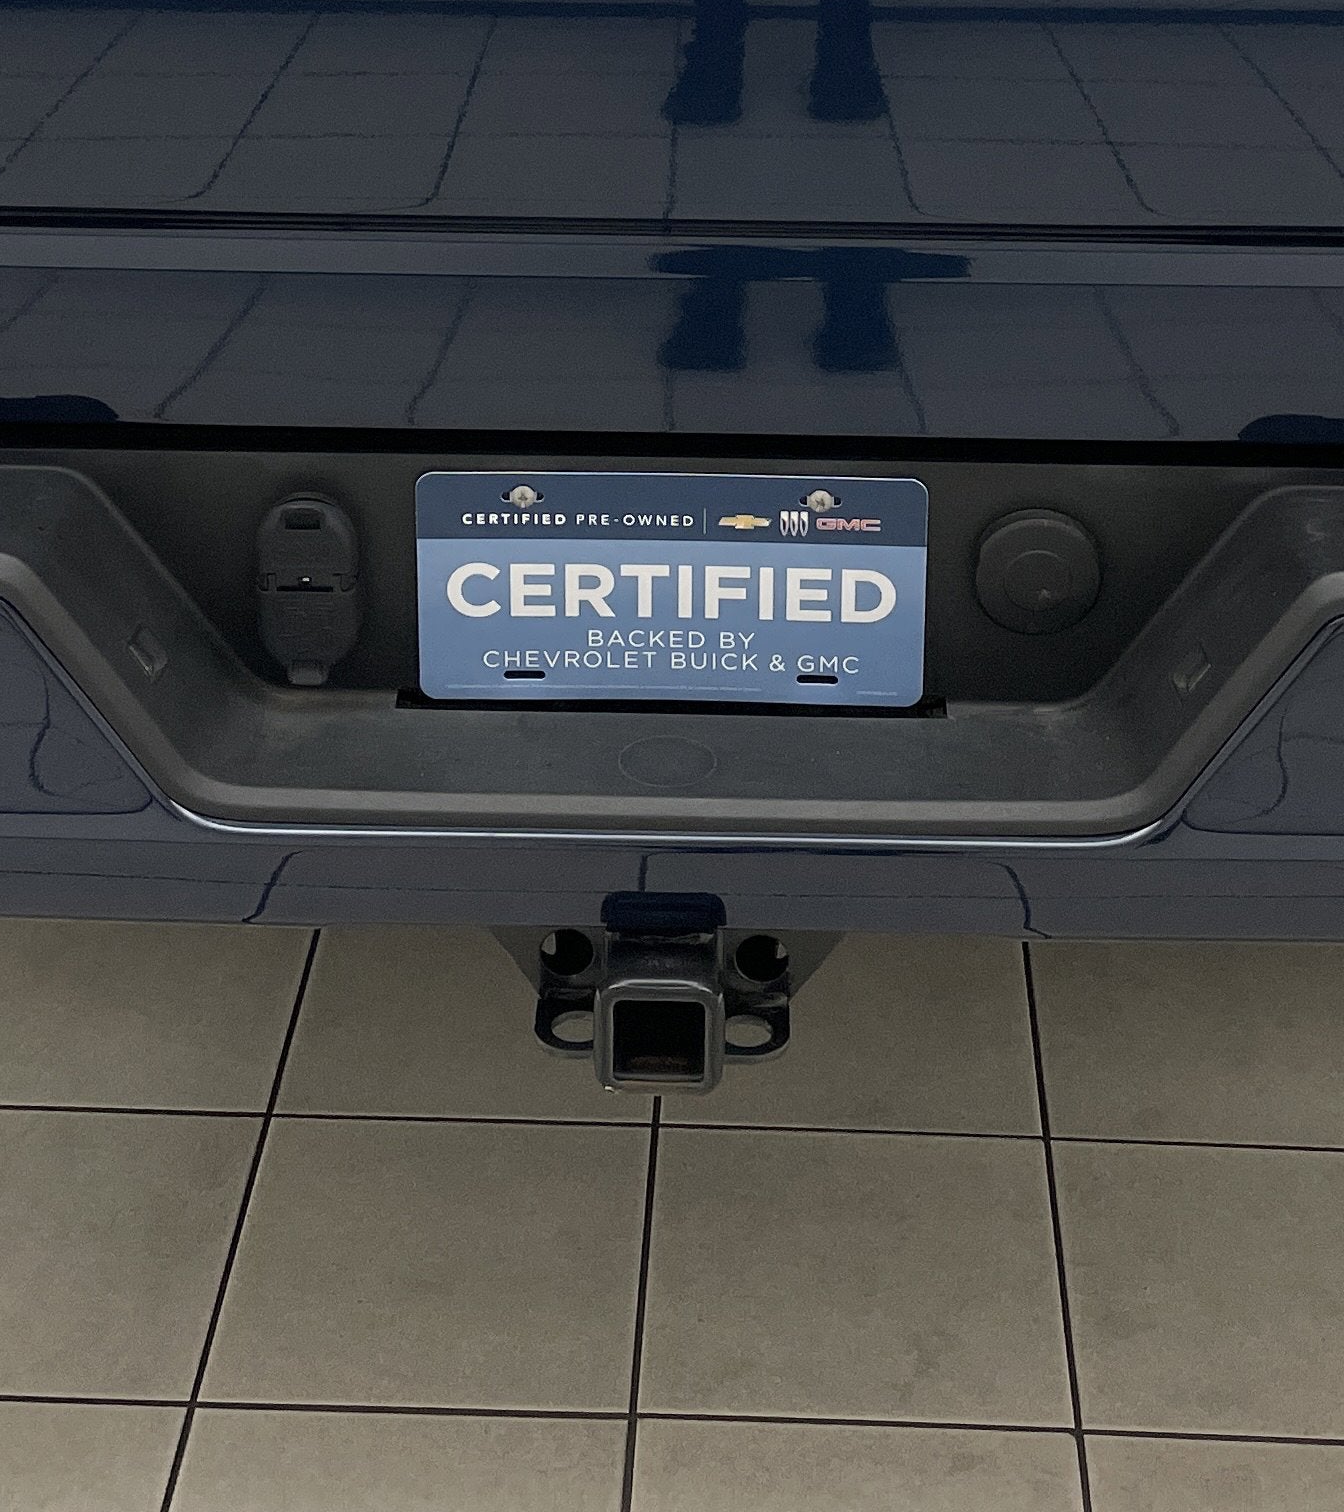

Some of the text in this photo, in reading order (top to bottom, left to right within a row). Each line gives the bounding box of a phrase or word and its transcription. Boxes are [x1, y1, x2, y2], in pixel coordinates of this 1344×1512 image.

[462, 513, 695, 527] CERTIFIED PRE-OWNED
[816, 517, 882, 532] GMC
[446, 562, 897, 623] CERTIFIED
[587, 629, 756, 650] BACKED BY
[482, 650, 860, 674] CHEVROLET BUICK & GMC
